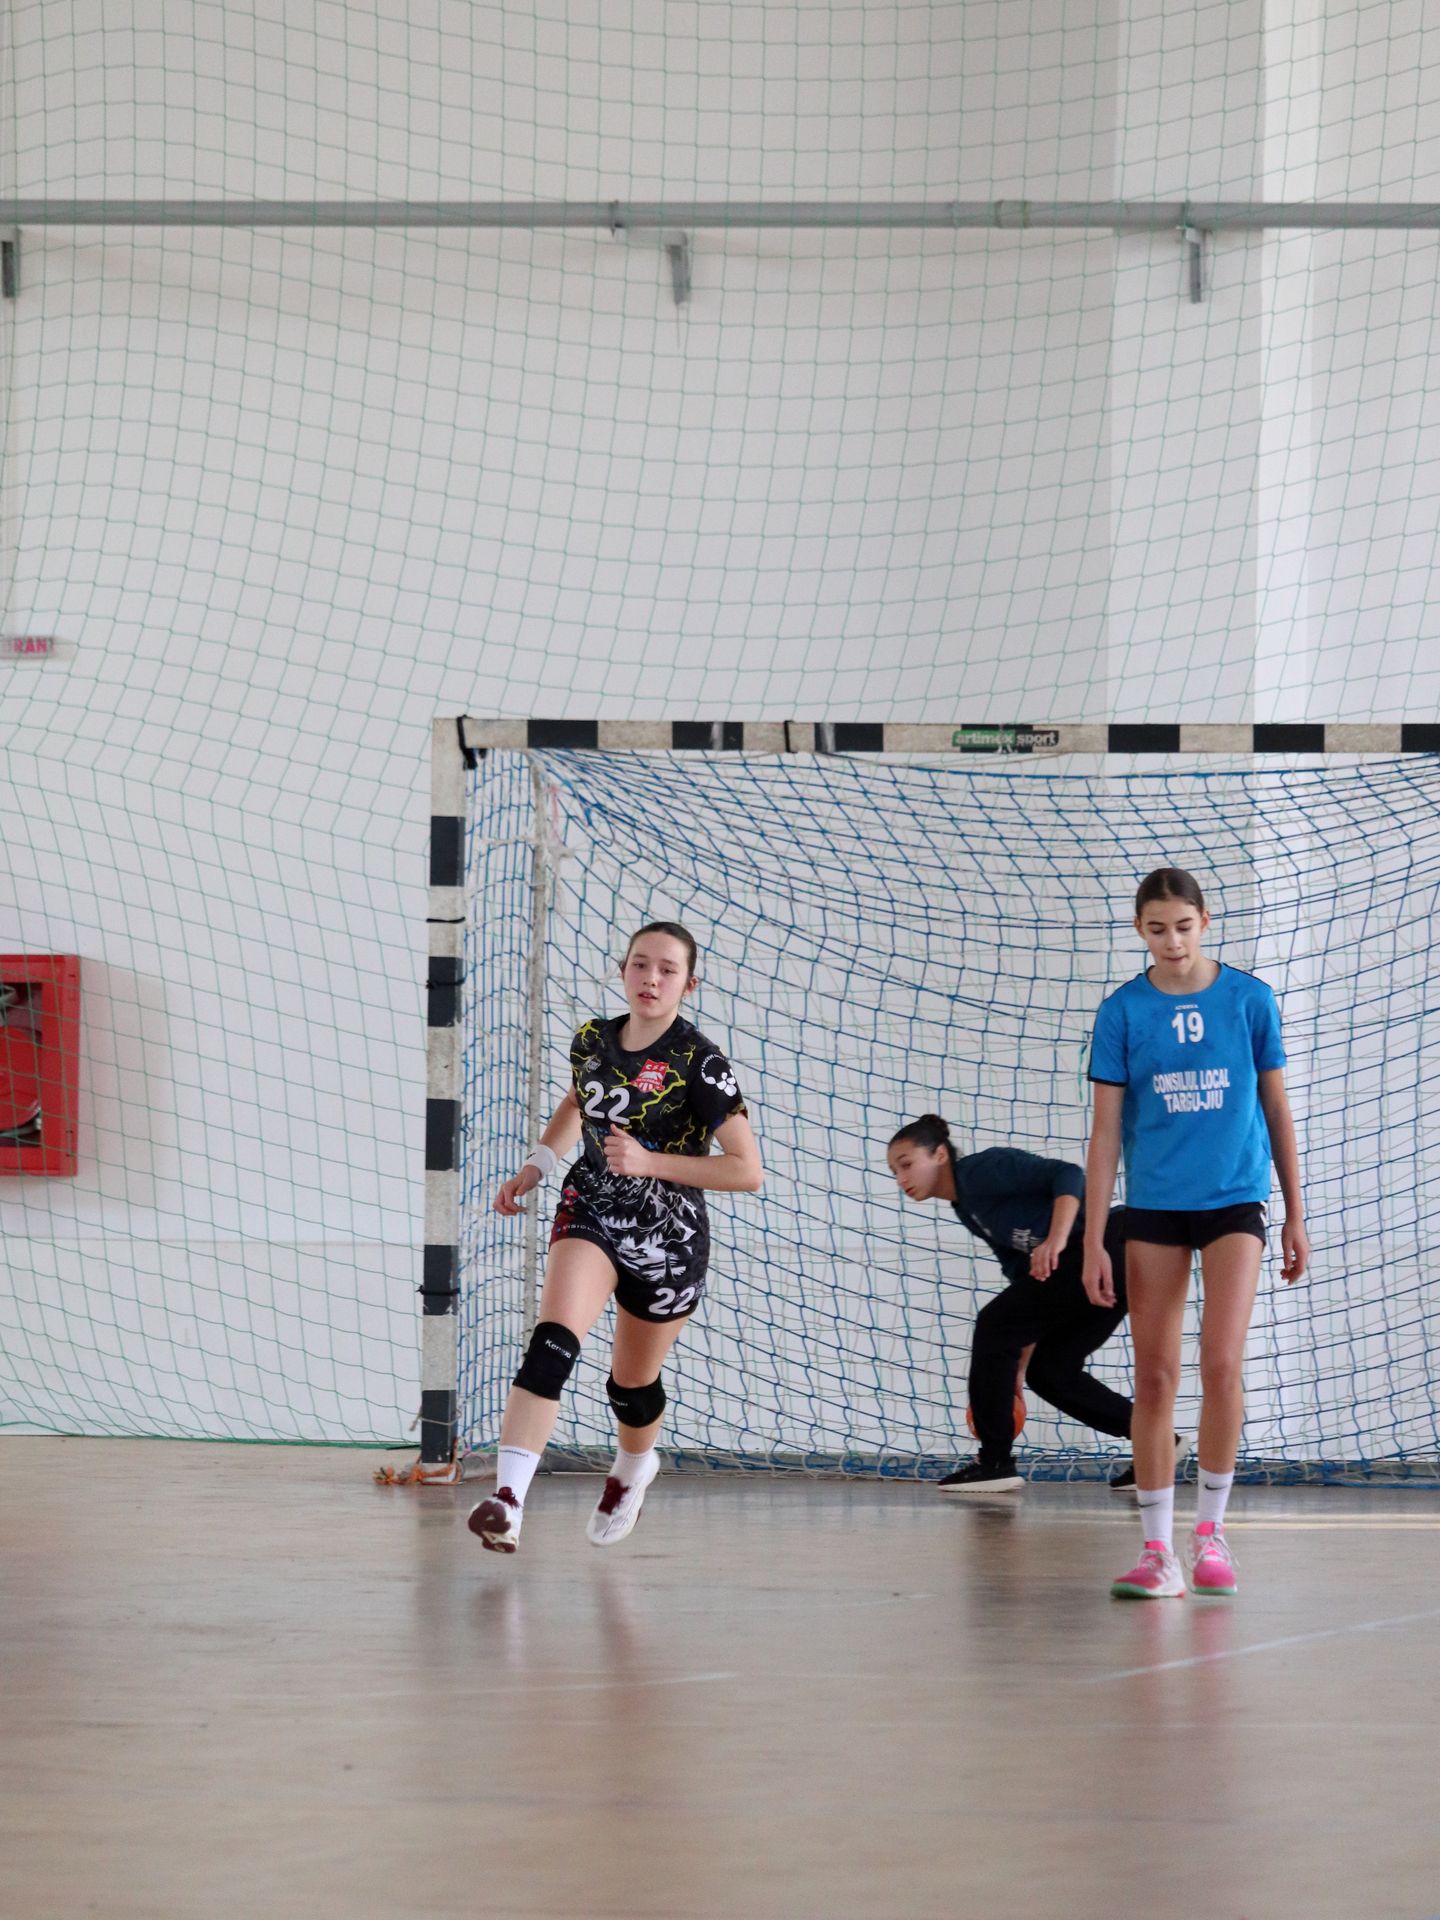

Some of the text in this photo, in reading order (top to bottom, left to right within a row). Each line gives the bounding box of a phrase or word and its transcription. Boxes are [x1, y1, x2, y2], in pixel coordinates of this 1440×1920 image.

[1016, 732, 1056, 748] sport
[1171, 1011, 1204, 1043] 19
[1153, 1068, 1230, 1094] CONSILIUL LOCAL
[584, 1080, 630, 1126] 22
[648, 1286, 695, 1315] 22
